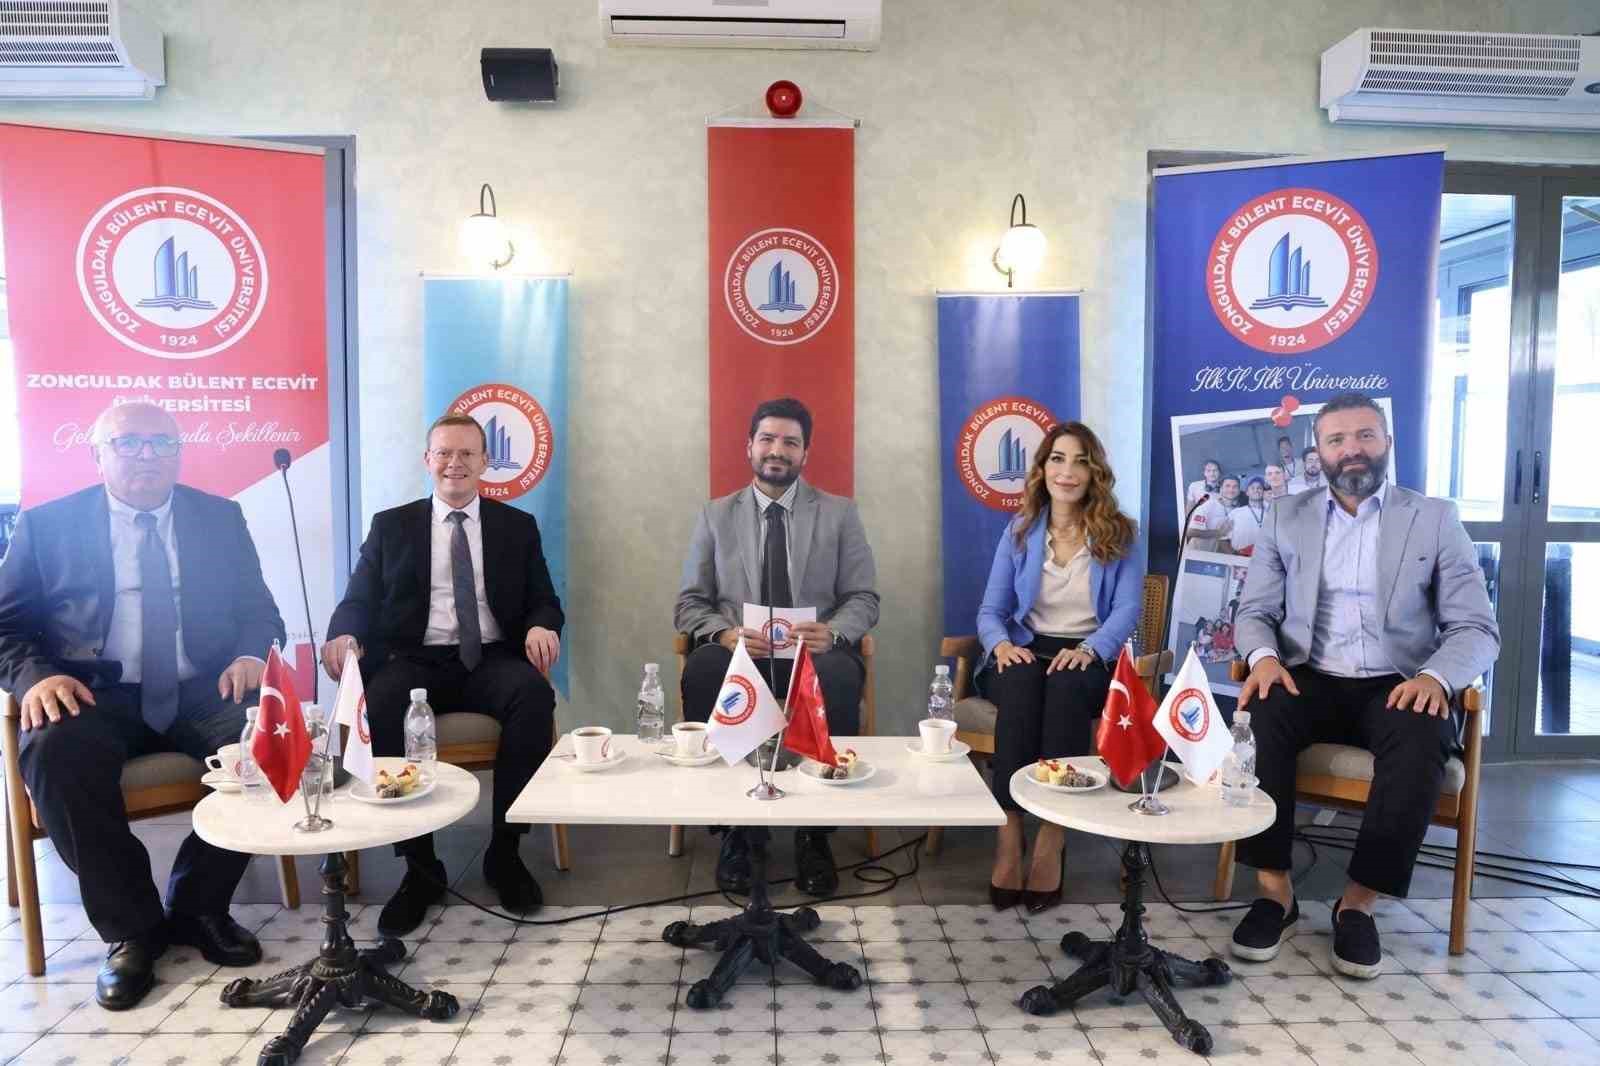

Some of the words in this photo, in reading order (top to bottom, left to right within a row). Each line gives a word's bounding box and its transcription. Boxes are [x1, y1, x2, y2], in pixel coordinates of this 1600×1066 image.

[106, 199, 168, 235] BÜLENT
[174, 201, 233, 235] ECEVİT
[1228, 197, 1286, 239] BÜLENT
[1292, 196, 1351, 225] ECEVİT
[91, 235, 142, 333] ZONGULDAK
[214, 236, 255, 338] ÜNİVERSİTESİ
[1213, 240, 1253, 335] ZONGULDAK
[1323, 225, 1371, 336] ÜNİVERSİTESİ
[160, 334, 198, 346] 1924
[1269, 334, 1306, 346] 1924
[27, 374, 162, 389] ZONGULDAK
[168, 374, 247, 390] BÜLENT
[252, 374, 318, 391] ECEVİT
[1286, 363, 1389, 391] Üniversite
[497, 389, 534, 414] ECEVİT
[1012, 402, 1049, 425] ECEVİT
[972, 402, 1008, 433] BÜLENT
[216, 422, 303, 448] Şekillenir
[961, 431, 990, 499] ZONGULDAK
[484, 486, 509, 496] 1924
